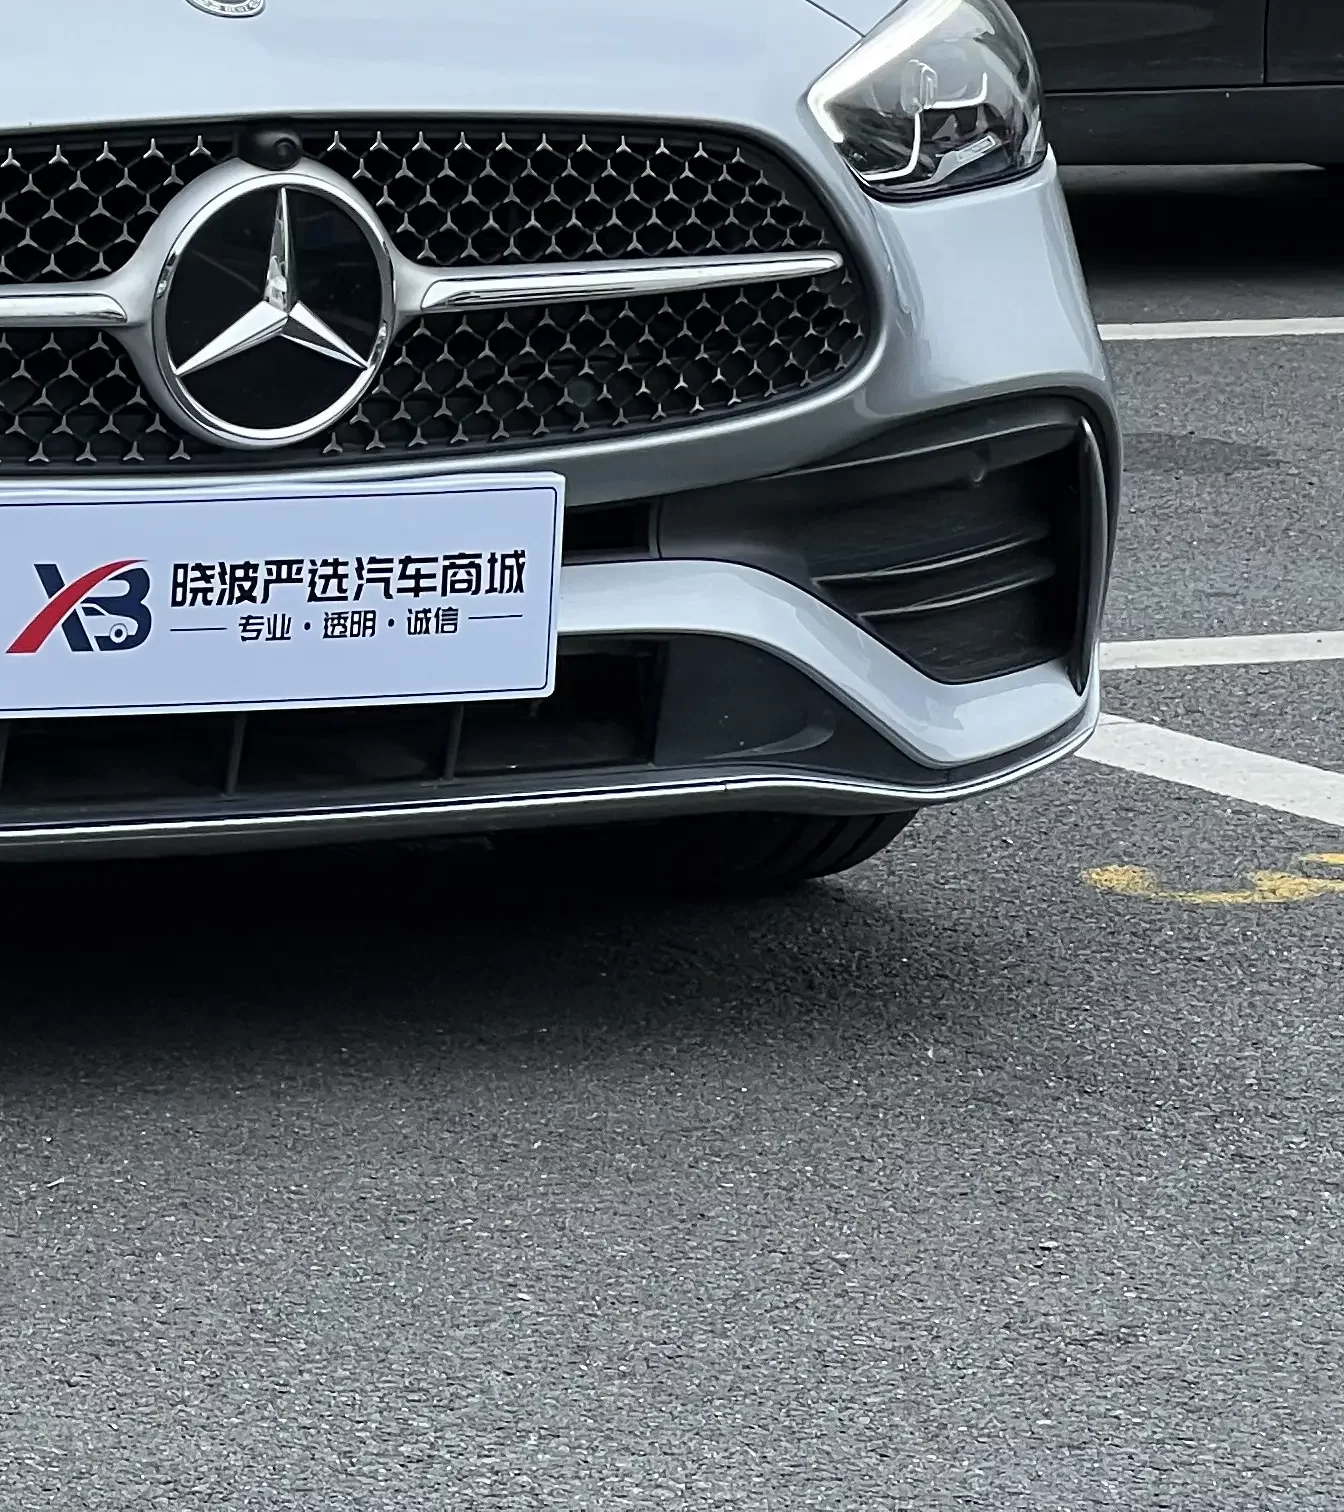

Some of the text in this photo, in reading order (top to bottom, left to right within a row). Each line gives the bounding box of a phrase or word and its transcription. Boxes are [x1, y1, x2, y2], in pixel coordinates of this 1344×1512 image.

[169, 550, 527, 608] 晓波严选汽车商城
